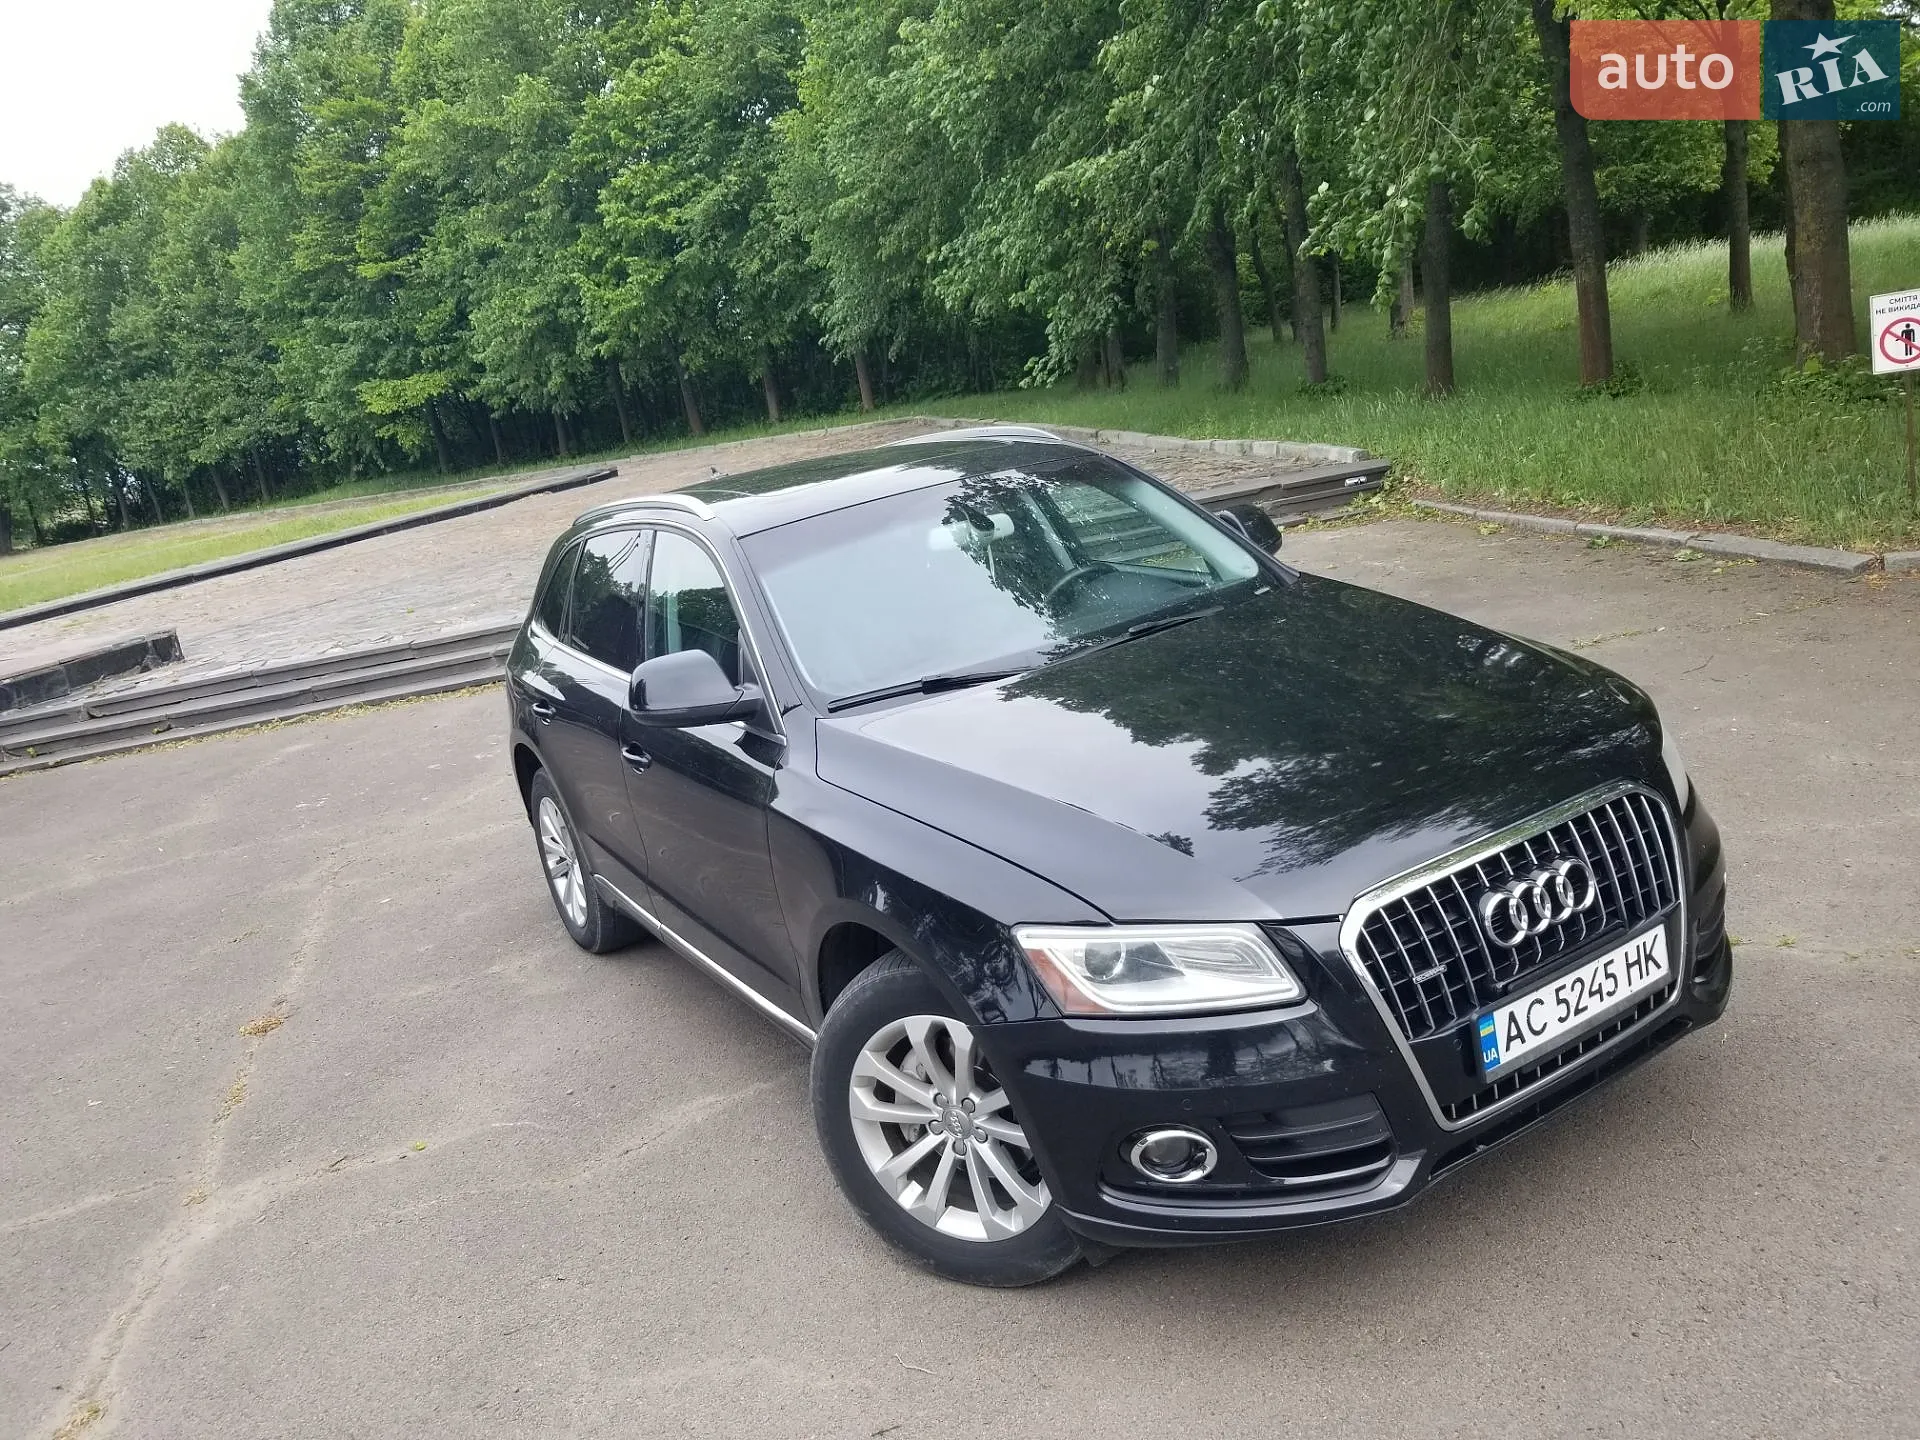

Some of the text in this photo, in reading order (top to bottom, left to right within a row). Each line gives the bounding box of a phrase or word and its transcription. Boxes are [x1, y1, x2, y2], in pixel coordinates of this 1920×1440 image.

[1889, 295, 1918, 305] СМІТТЯ
[1505, 934, 1663, 1052] AC 5245 HK
[1483, 1049, 1499, 1063] UA
